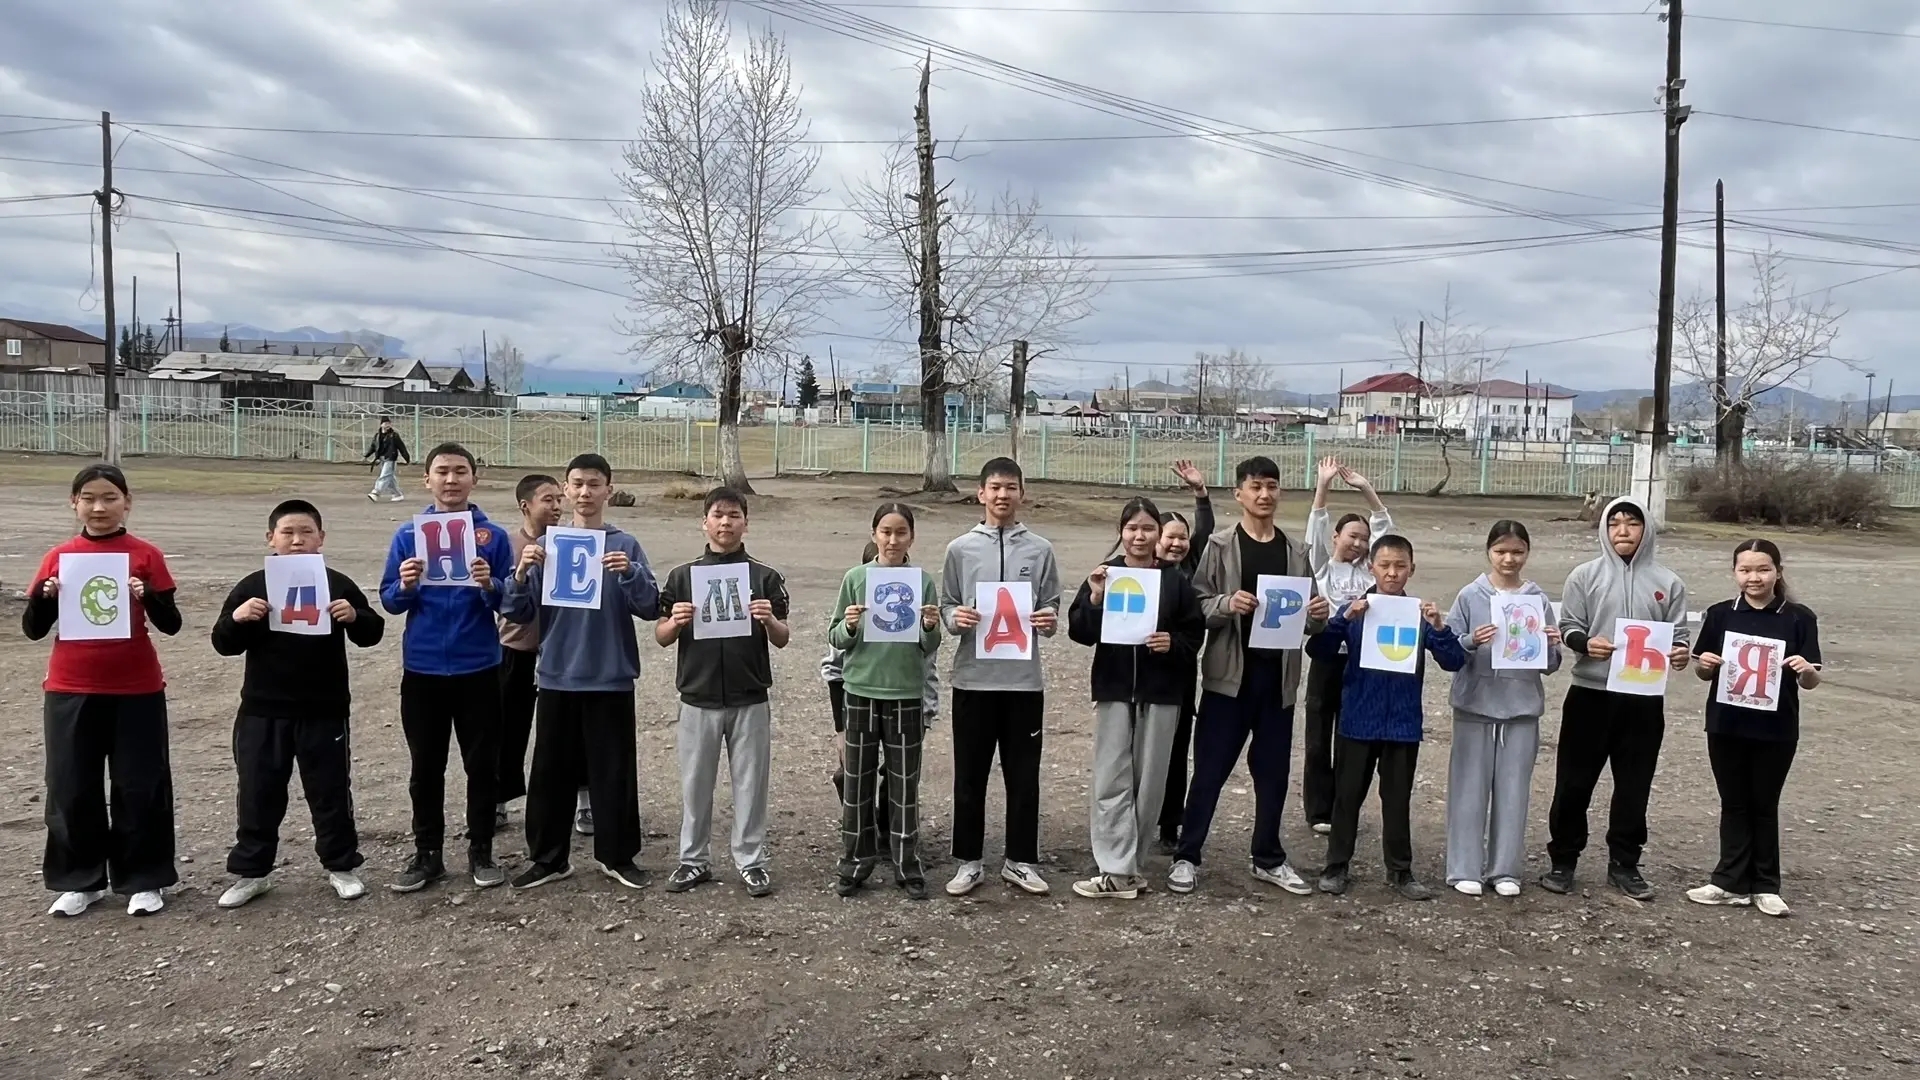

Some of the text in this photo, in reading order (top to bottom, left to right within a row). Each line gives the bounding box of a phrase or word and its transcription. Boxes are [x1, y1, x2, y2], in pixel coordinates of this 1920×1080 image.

[420, 518, 471, 582] Н
[549, 533, 597, 604] Е
[80, 575, 119, 626] С
[281, 569, 320, 626] Д
[701, 576, 748, 623] М
[1260, 589, 1303, 629] Р
[1501, 603, 1541, 662] В
[1616, 625, 1666, 685] Ь
[1726, 642, 1776, 699] Я
